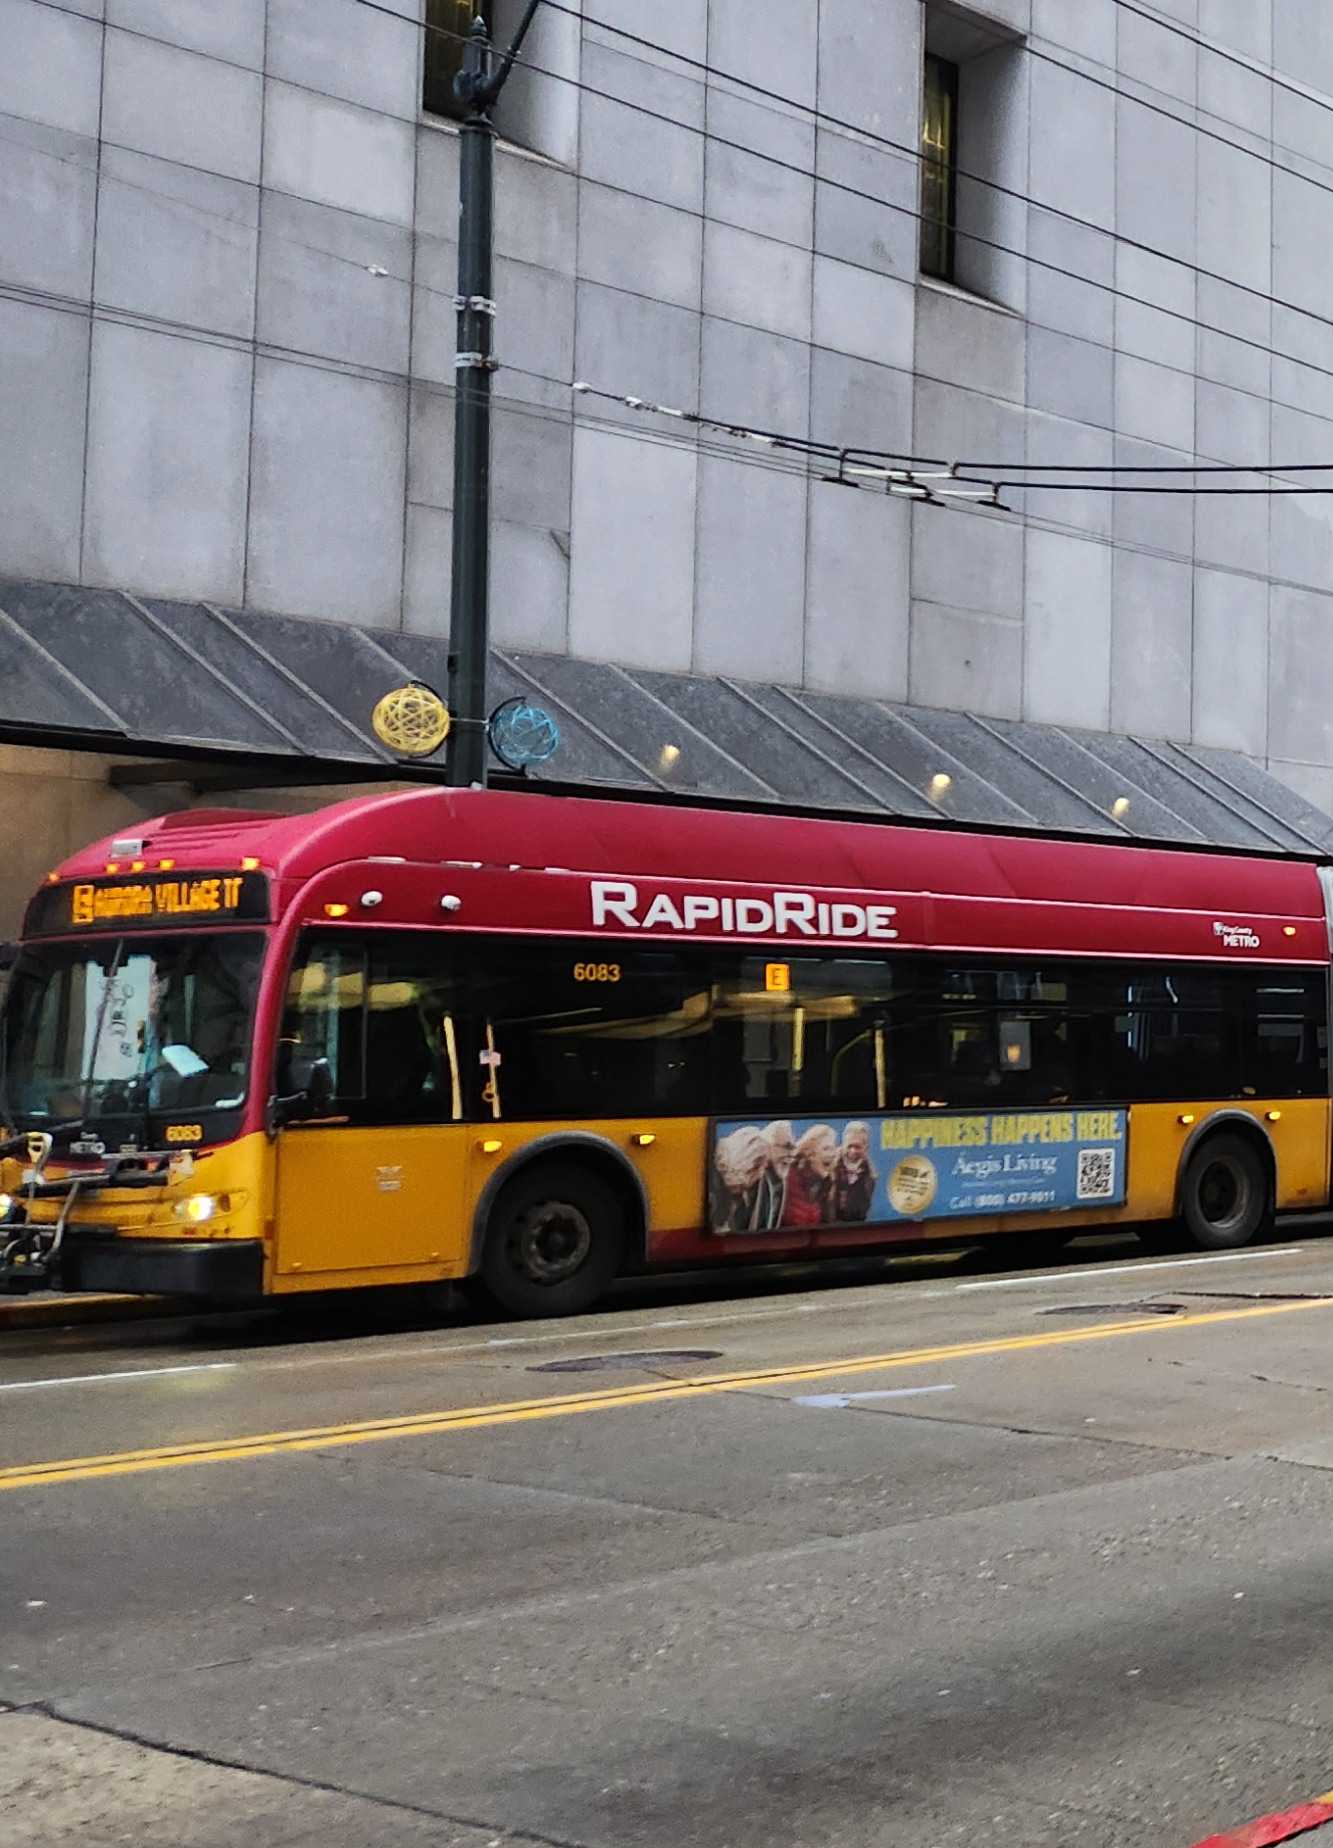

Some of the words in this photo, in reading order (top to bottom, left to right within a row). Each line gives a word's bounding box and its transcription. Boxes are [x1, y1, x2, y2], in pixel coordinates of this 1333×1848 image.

[1223, 935, 1260, 948] METRO
[573, 963, 621, 982] 6083
[882, 1115, 986, 1149] HAPPINESS
[991, 1112, 1073, 1144] HAPPENS
[1003, 1154, 1057, 1175] Living
[951, 1196, 972, 1209] Call
